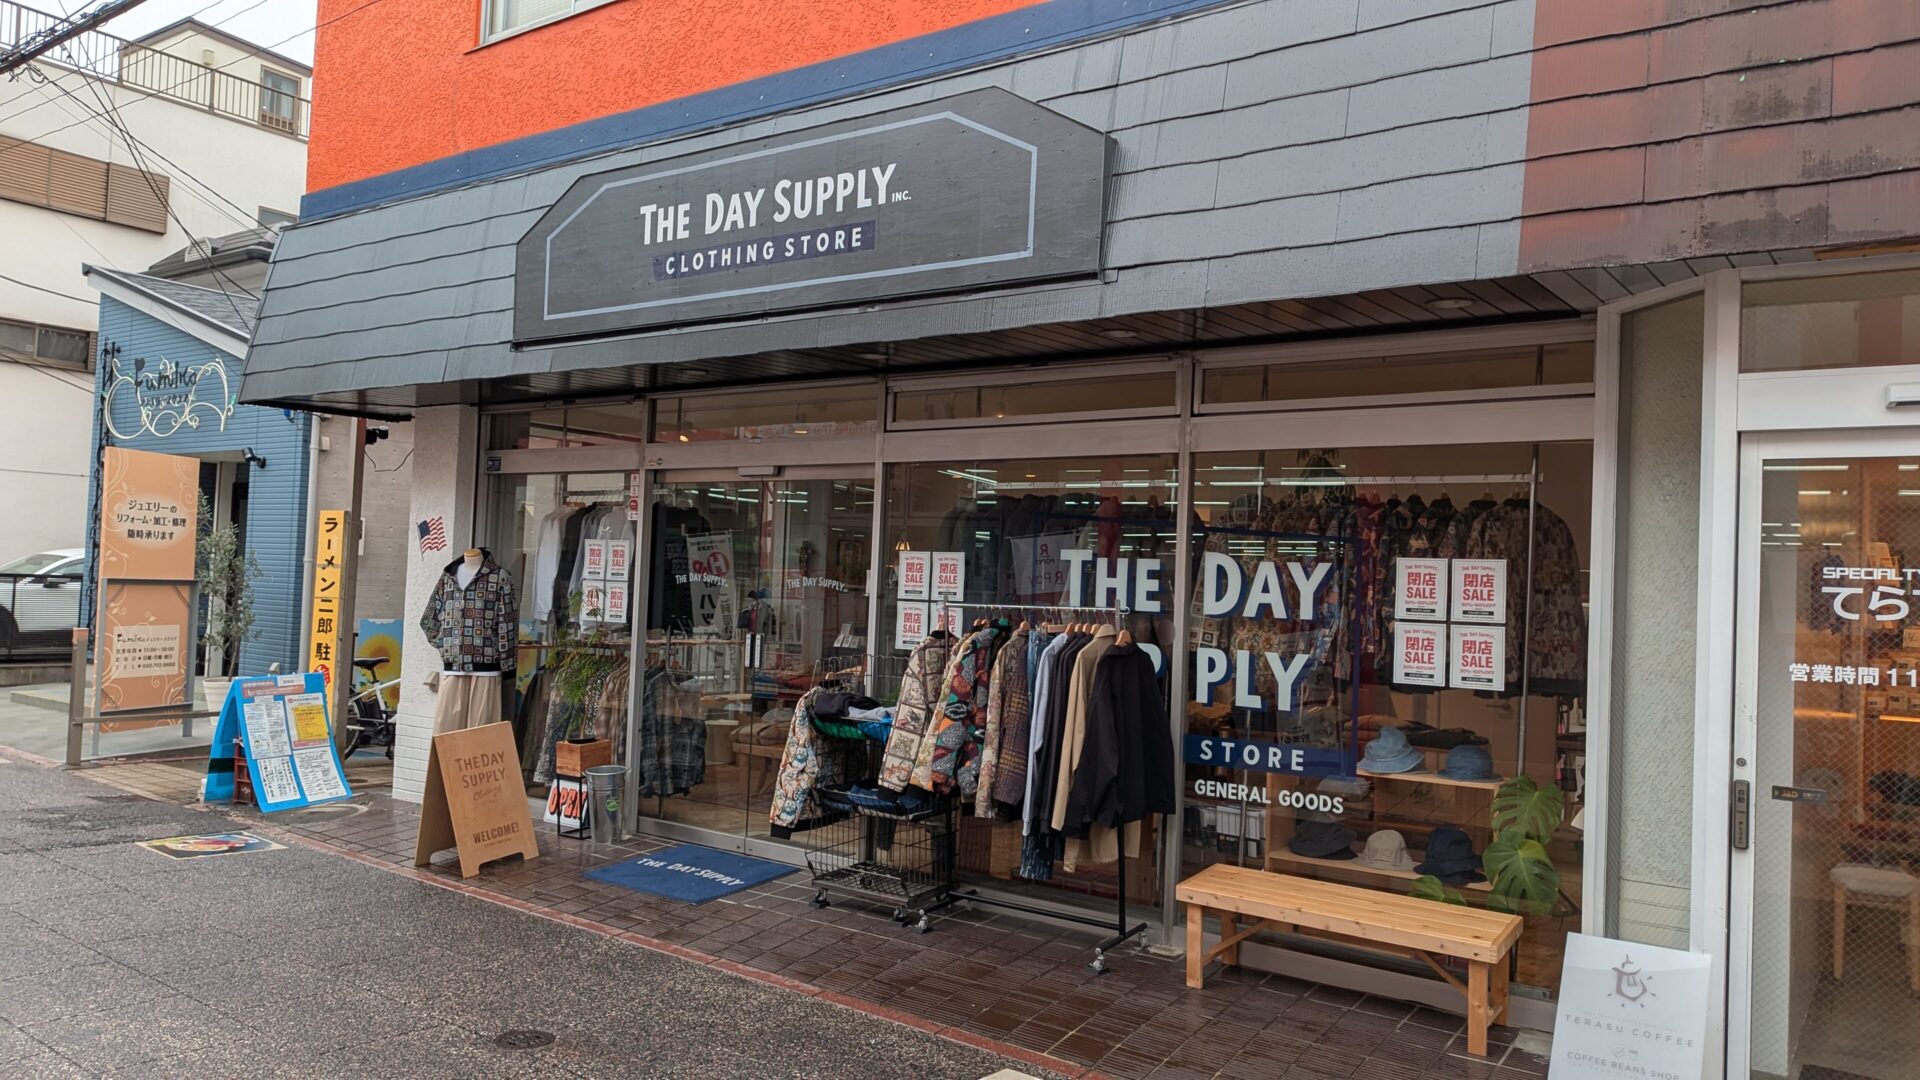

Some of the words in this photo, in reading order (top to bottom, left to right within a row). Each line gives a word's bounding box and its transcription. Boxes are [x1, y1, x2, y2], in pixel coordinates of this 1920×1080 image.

[640, 203, 690, 245] THE
[704, 188, 765, 235] DAY
[772, 163, 897, 223] SUPPLY
[892, 190, 912, 203] INC.
[666, 241, 774, 275] CLOTHING
[785, 227, 862, 257] STORE
[128, 500, 177, 513] ジュエリーの
[612, 559, 625, 567] SALE
[906, 562, 924, 573] 閉店
[940, 563, 958, 574] 閉店
[675, 574, 688, 584] THE
[689, 573, 701, 582] DAY
[702, 572, 727, 586] SUPPLY
[787, 578, 801, 589] THE
[802, 576, 818, 587] DAY
[818, 576, 845, 591] SUPPLY
[905, 574, 923, 583] SALE
[938, 575, 958, 584] SALE
[1060, 549, 1161, 613] THE
[1203, 551, 1333, 620] DAY
[1408, 572, 1436, 586] 閉店
[1464, 573, 1495, 588] 閉店
[1407, 587, 1436, 599] SALE
[1462, 588, 1494, 601] SALE
[610, 600, 623, 609] SALE
[1822, 586, 1920, 621] てら
[904, 613, 922, 624] 閉店
[903, 625, 922, 634] SALE
[1406, 636, 1435, 652] 閉店
[1462, 640, 1493, 655] 閉店
[1405, 651, 1434, 664] SALE
[1461, 655, 1493, 668] SALE
[1789, 663, 1879, 686] 営業時間
[455, 756, 480, 772] THE
[481, 751, 505, 768] DAY
[1200, 740, 1304, 771] STORE
[462, 768, 506, 789] SUPPLY
[549, 786, 587, 818] OPEN
[1194, 779, 1272, 804] GENERAL
[1278, 789, 1344, 814] GOODS
[473, 822, 520, 844] WELCOME!
[637, 858, 667, 868] THE
[667, 863, 700, 873] DAY
[694, 869, 745, 886] SUPPLY
[1565, 1014, 1624, 1033] TERASU
[1632, 1028, 1694, 1047] COFFEE
[1567, 1051, 1608, 1066] COFFEE
[1611, 1061, 1646, 1075] BEANS
[1650, 1070, 1680, 1080] SHOP
